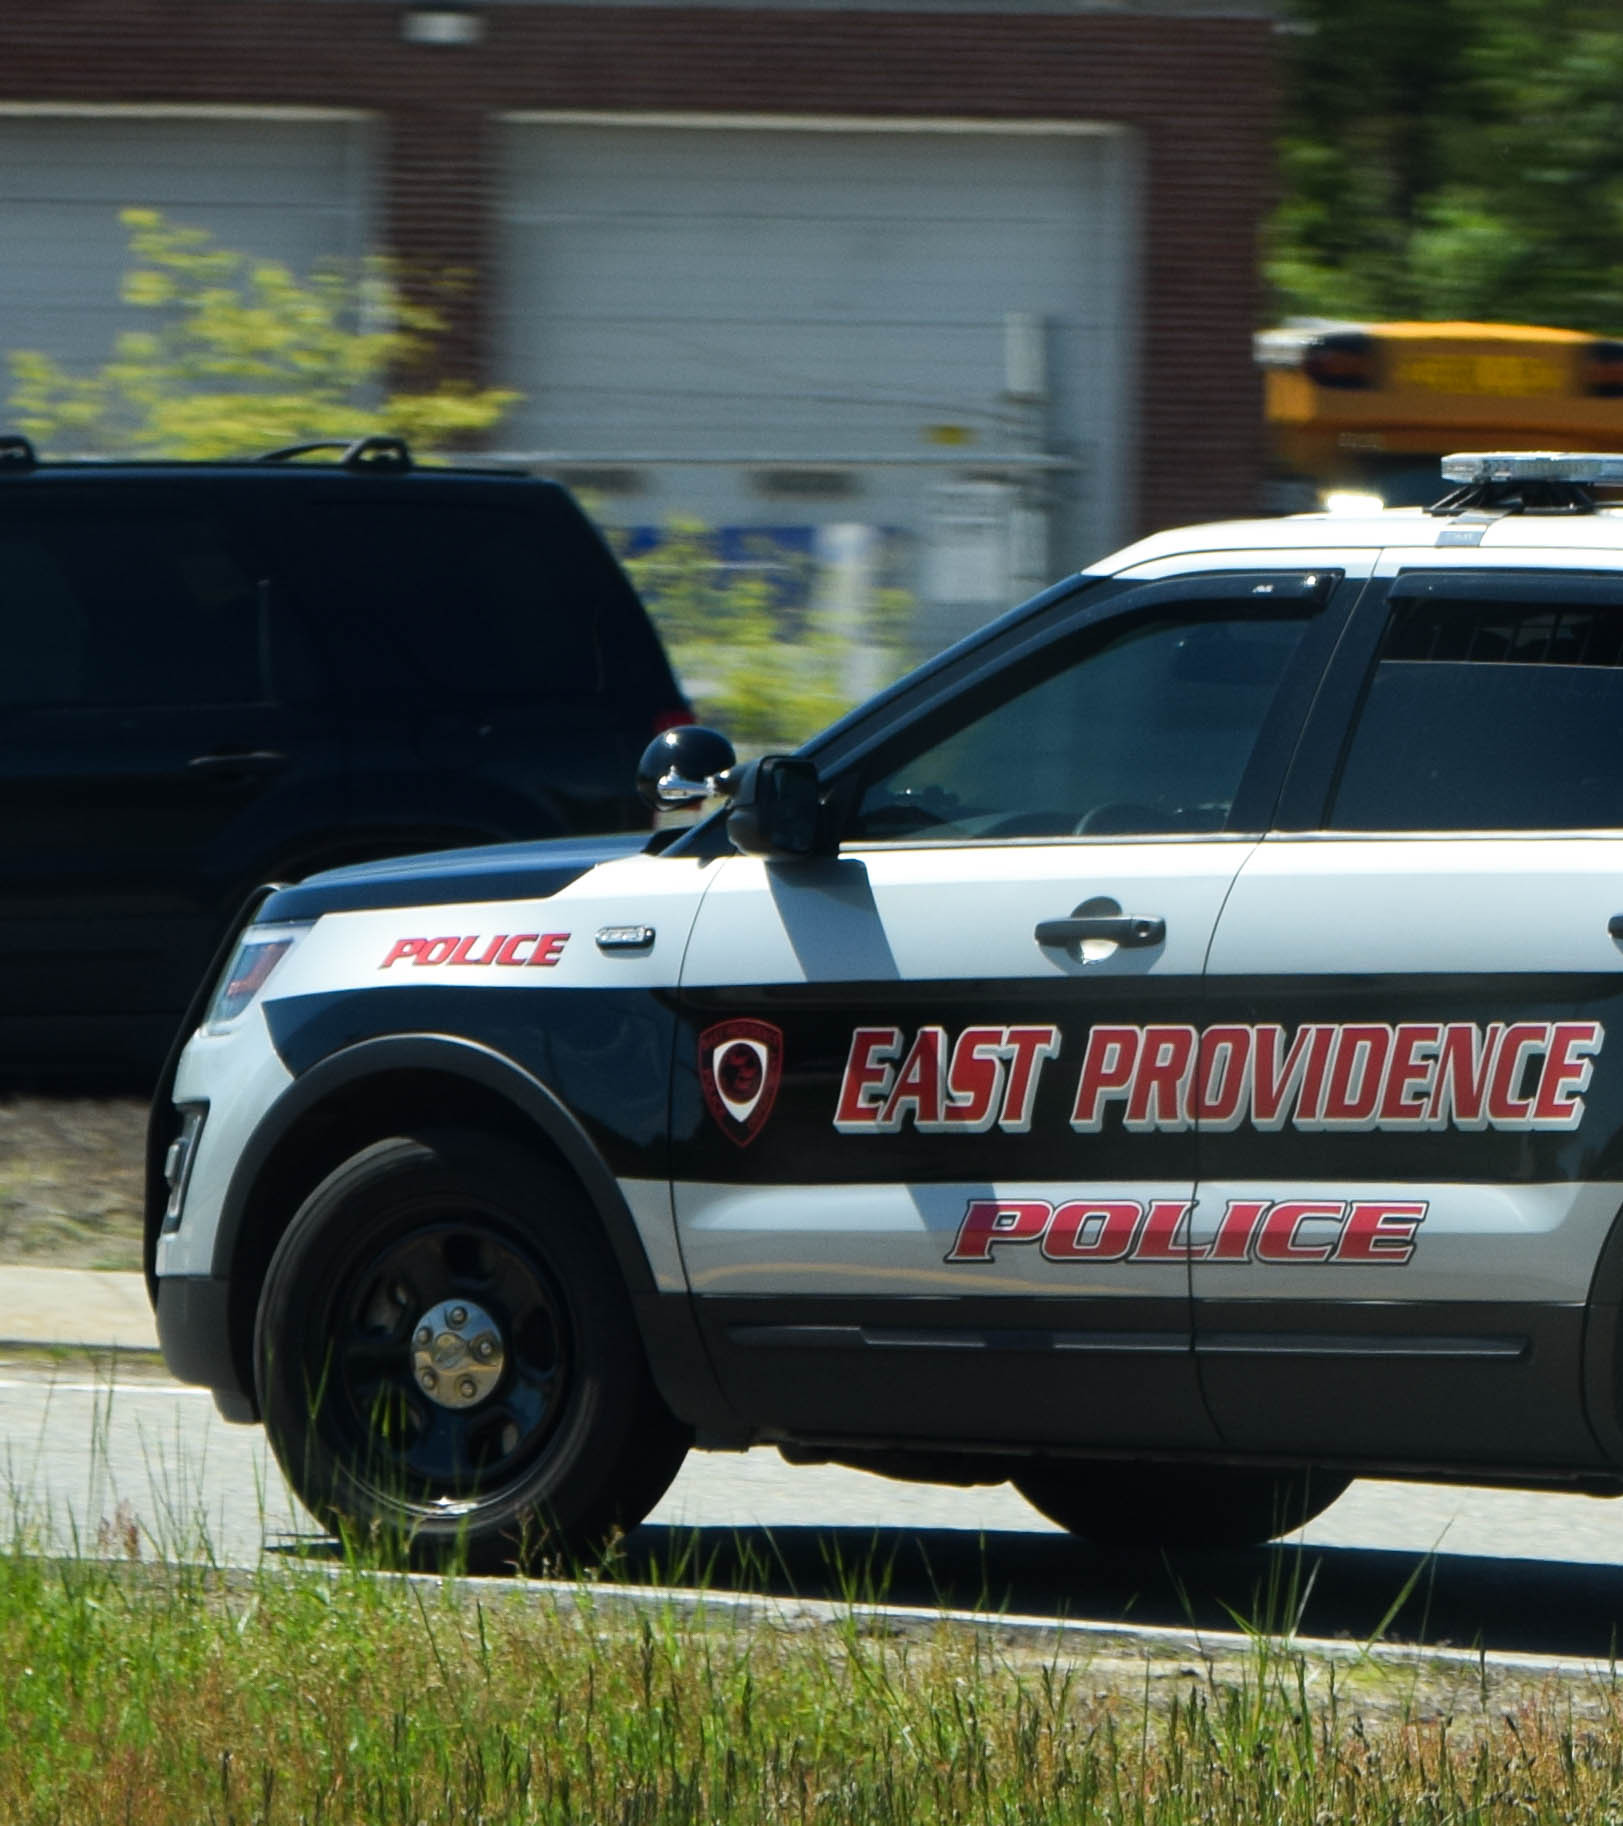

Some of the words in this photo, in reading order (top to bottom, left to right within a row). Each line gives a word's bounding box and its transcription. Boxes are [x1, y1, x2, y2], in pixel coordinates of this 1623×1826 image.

[378, 932, 571, 970] POLICE
[833, 1026, 1061, 1133] EAST
[1070, 1021, 1605, 1132] PROVIDENCE
[944, 1200, 1428, 1265] POLICE
